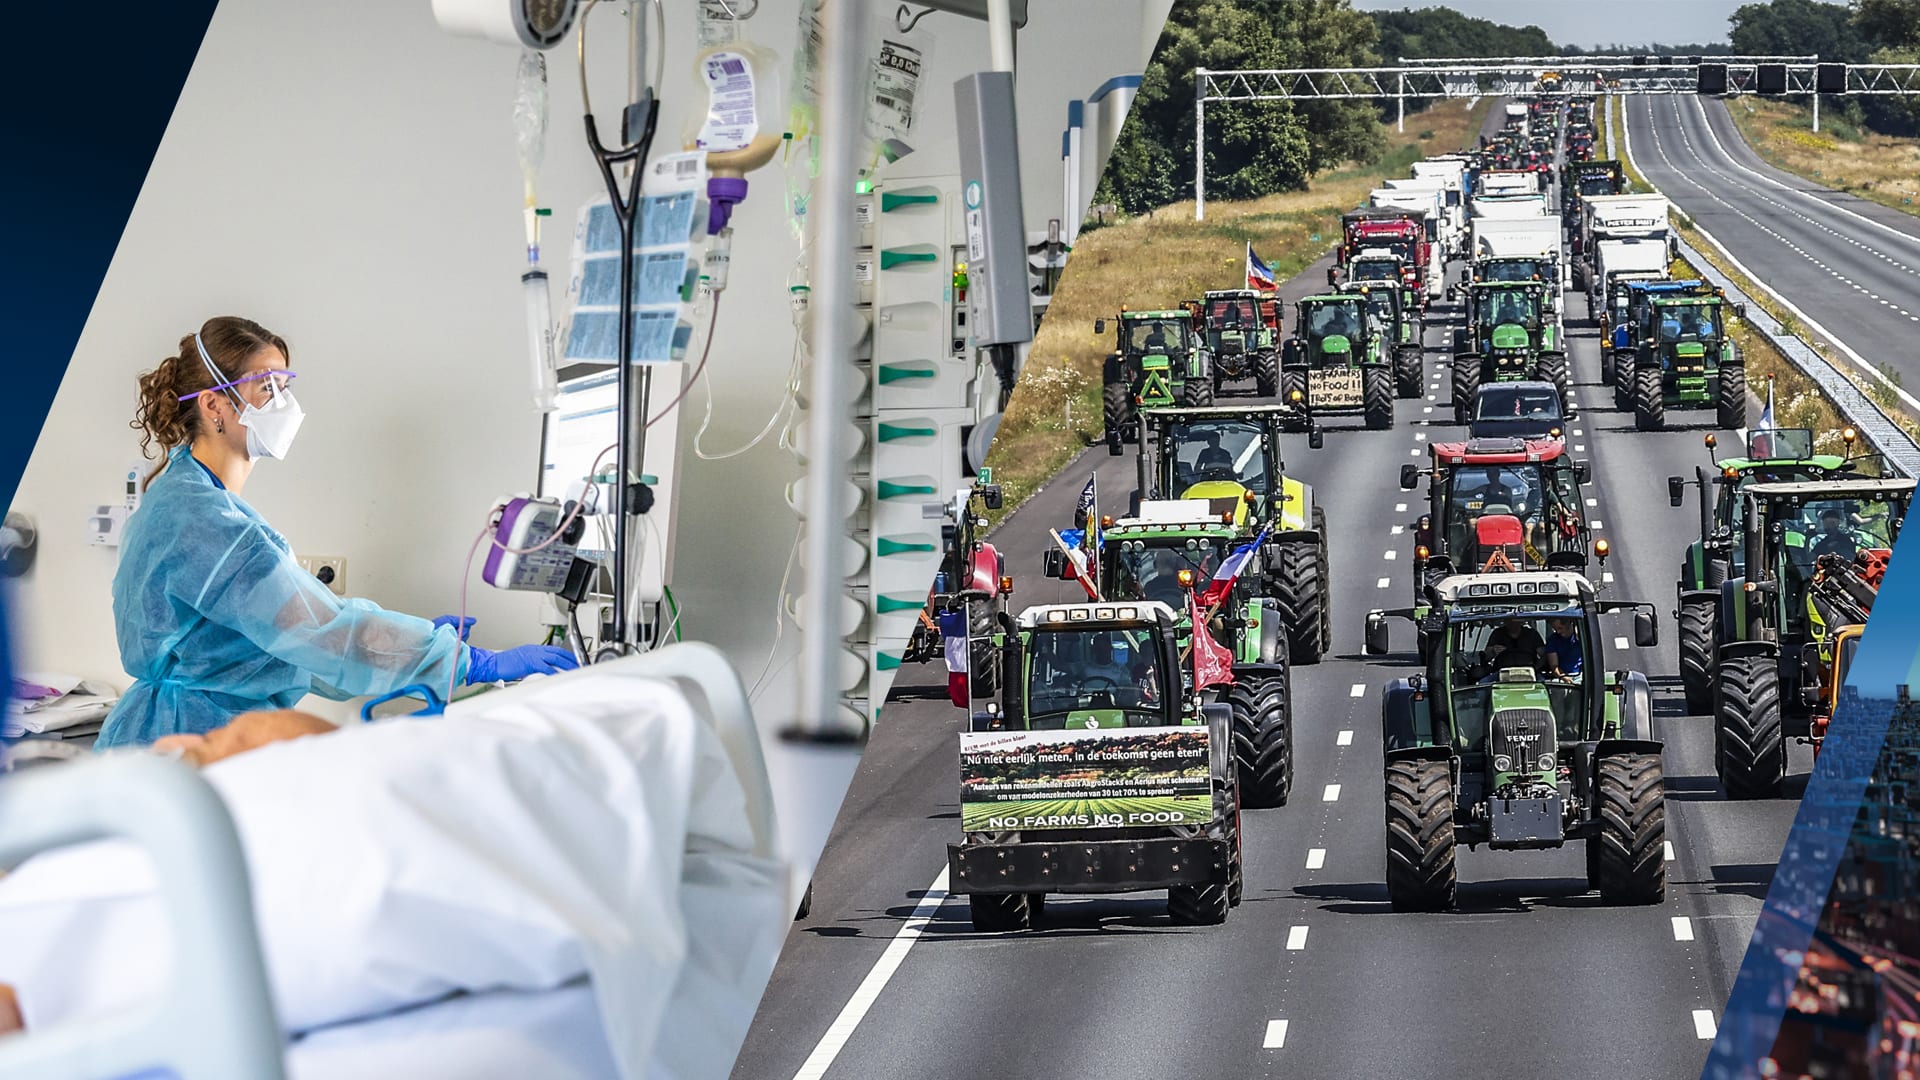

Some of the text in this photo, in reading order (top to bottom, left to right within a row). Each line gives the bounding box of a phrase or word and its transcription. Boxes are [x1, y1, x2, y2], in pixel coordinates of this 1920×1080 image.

[1507, 734, 1540, 742] FENDT
[984, 754, 1003, 764] niet
[1006, 753, 1036, 764] eerlijk
[1038, 754, 1072, 763] meten,
[1087, 750, 1100, 760] de
[1102, 750, 1148, 760] toekomst
[1150, 750, 1174, 760] geen
[989, 812, 1184, 827] NO FARMS NO FOOD
